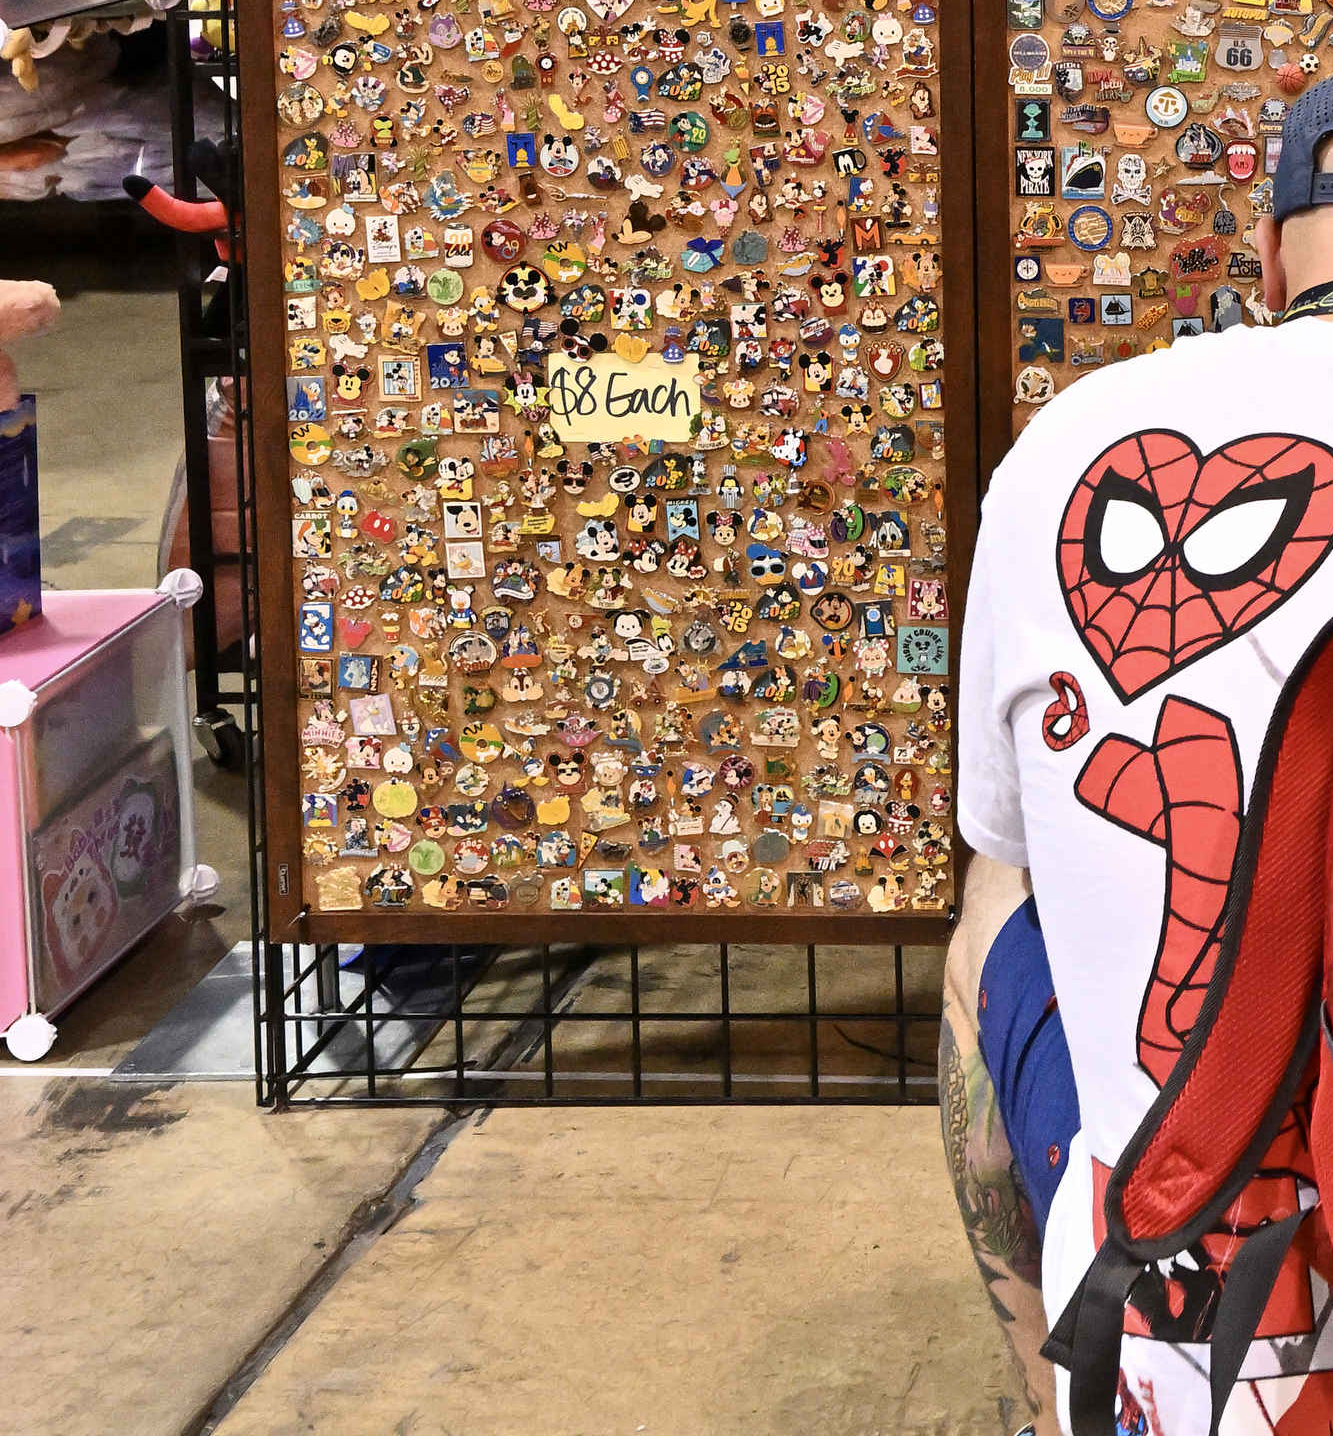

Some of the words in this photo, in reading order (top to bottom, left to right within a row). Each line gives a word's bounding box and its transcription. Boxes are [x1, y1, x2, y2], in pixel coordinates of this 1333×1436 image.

[1224, 48, 1254, 67] 66
[1016, 149, 1034, 163] NEW
[1019, 179, 1051, 196] PIRATE
[551, 365, 597, 426] $8
[606, 373, 691, 418] Each
[293, 511, 330, 521] CARROT
[371, 658, 382, 693] JAZZ
